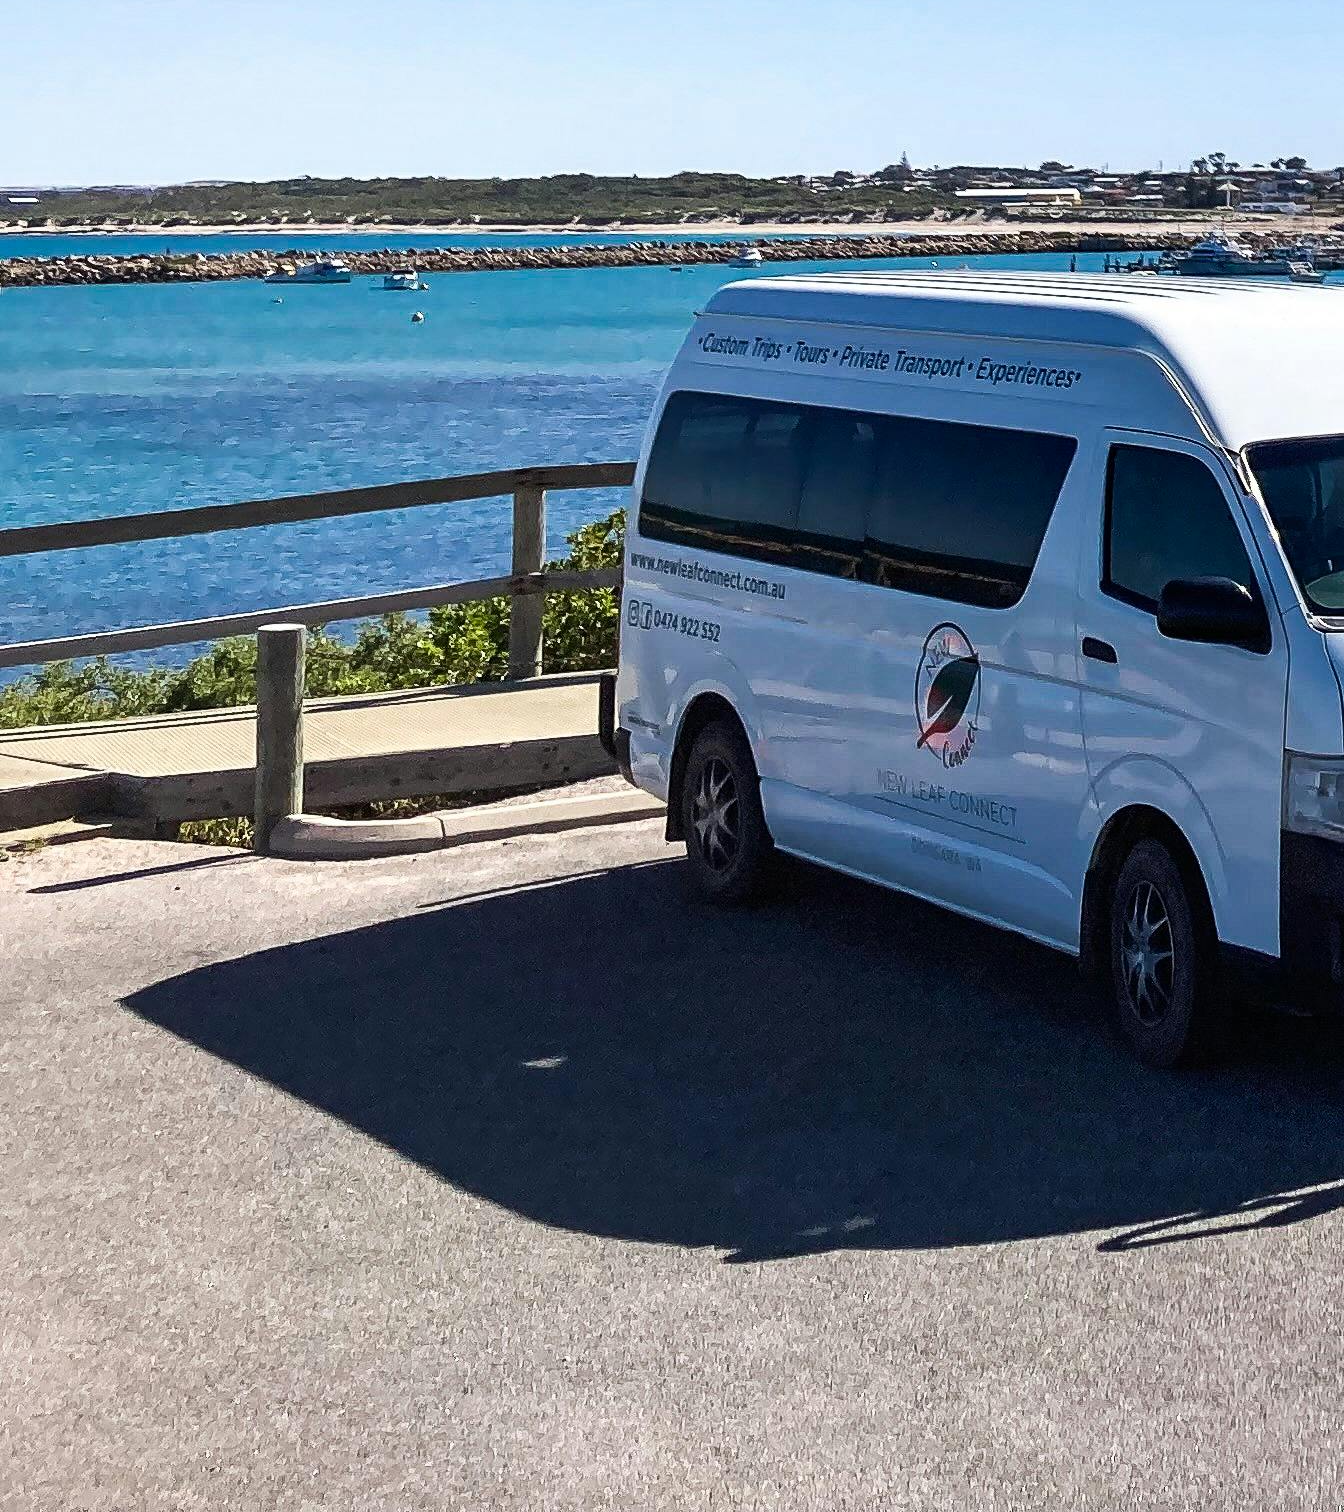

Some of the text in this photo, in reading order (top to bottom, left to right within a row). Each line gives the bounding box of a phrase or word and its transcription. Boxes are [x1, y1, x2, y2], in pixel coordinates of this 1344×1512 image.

[702, 333, 1076, 389] Custom Trips Tours Private Transport Experiences
[630, 552, 786, 600] www.newleafconnect.com.au
[653, 609, 679, 632] 0474
[680, 616, 699, 638] 922
[911, 781, 946, 803] LEAF
[950, 790, 1017, 827] CONNECT
